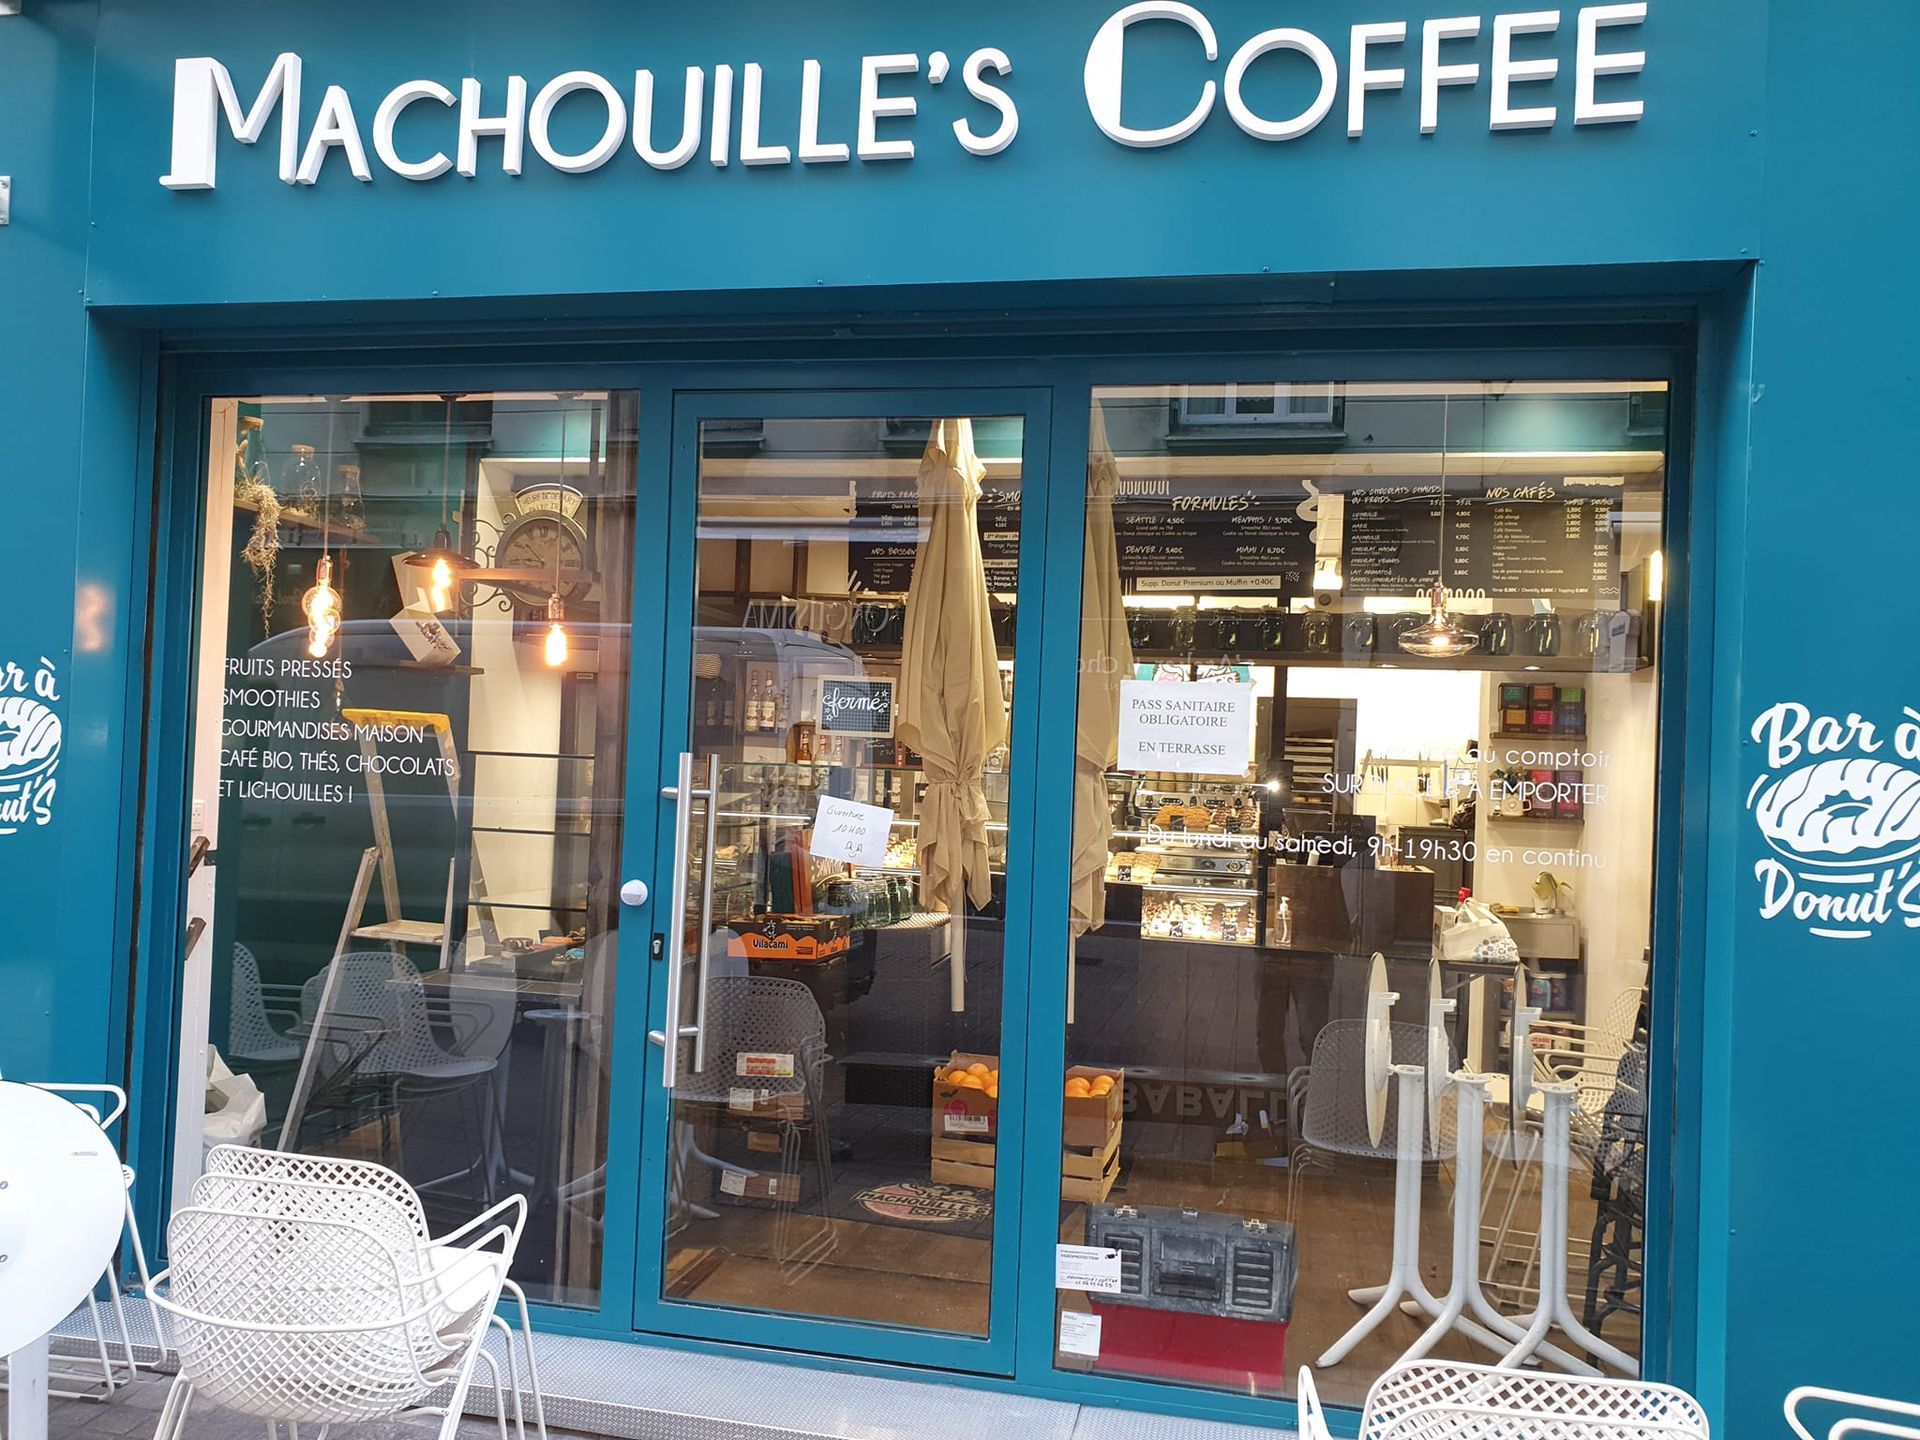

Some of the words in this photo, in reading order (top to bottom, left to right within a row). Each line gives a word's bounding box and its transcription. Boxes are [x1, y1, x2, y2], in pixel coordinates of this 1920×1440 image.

[158, 47, 1019, 191] MACHOUILLE'S
[1083, 0, 1649, 148] COFFEE
[998, 490, 1021, 503] SMO
[1486, 486, 1510, 499] NOS
[1512, 481, 1556, 499] CAFÉS
[1171, 495, 1249, 511] FORMULES
[1125, 516, 1156, 524] SEATTLE
[1125, 545, 1156, 554] DENVER
[1226, 578, 1248, 586] Muffin
[224, 657, 274, 676] FRUITS
[281, 658, 352, 678] PRESSÉS
[35, 656, 61, 701] à
[223, 688, 321, 709] SMOOTHIES
[822, 687, 889, 718] fermé
[1132, 699, 1162, 710] PASS
[1165, 700, 1236, 713] SANITAIRE
[221, 719, 350, 741] GOURMANDISES
[354, 724, 424, 743] MAISON
[1139, 714, 1228, 727] OBLIGATOIRE
[1750, 702, 1885, 769] Bar
[1138, 742, 1156, 752] EN
[1159, 742, 1226, 755] TERRASSE
[1505, 748, 1611, 770] comptoir
[219, 748, 258, 768] CAFÉ
[262, 751, 294, 770] BIO,
[299, 751, 340, 773] THÉS,
[345, 755, 455, 776] CHOCOLATS
[218, 780, 235, 798] ET
[239, 781, 343, 803] LICHOUILLES
[348, 786, 353, 803] !
[1322, 773, 1364, 795] SUR
[1490, 780, 1609, 805] EMPORTER
[826, 804, 865, 821] Ouverture
[1147, 824, 1174, 844] Du
[1183, 826, 1232, 848] lundi
[1240, 836, 1268, 850] au
[1276, 834, 1358, 858] samedi,
[1366, 836, 1478, 861] 9h-19h30
[1486, 848, 1513, 863] en
[1523, 848, 1607, 868] continu
